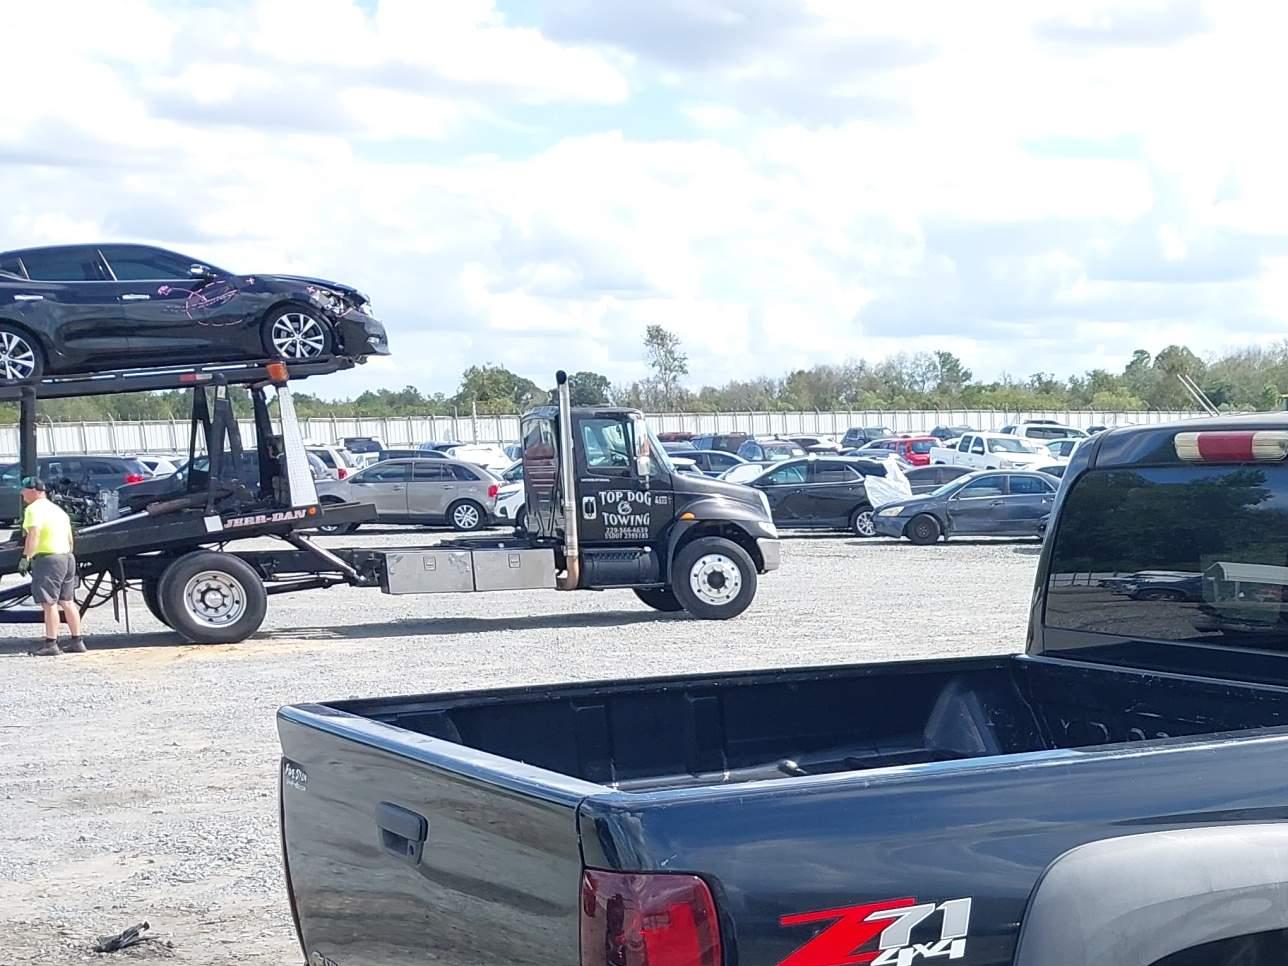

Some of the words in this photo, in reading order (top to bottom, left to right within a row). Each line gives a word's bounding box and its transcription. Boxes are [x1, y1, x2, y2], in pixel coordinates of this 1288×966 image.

[598, 491, 623, 506] TOP
[627, 491, 652, 506] DOG
[224, 509, 307, 529] JERR-DAN
[602, 512, 650, 526] TOWING
